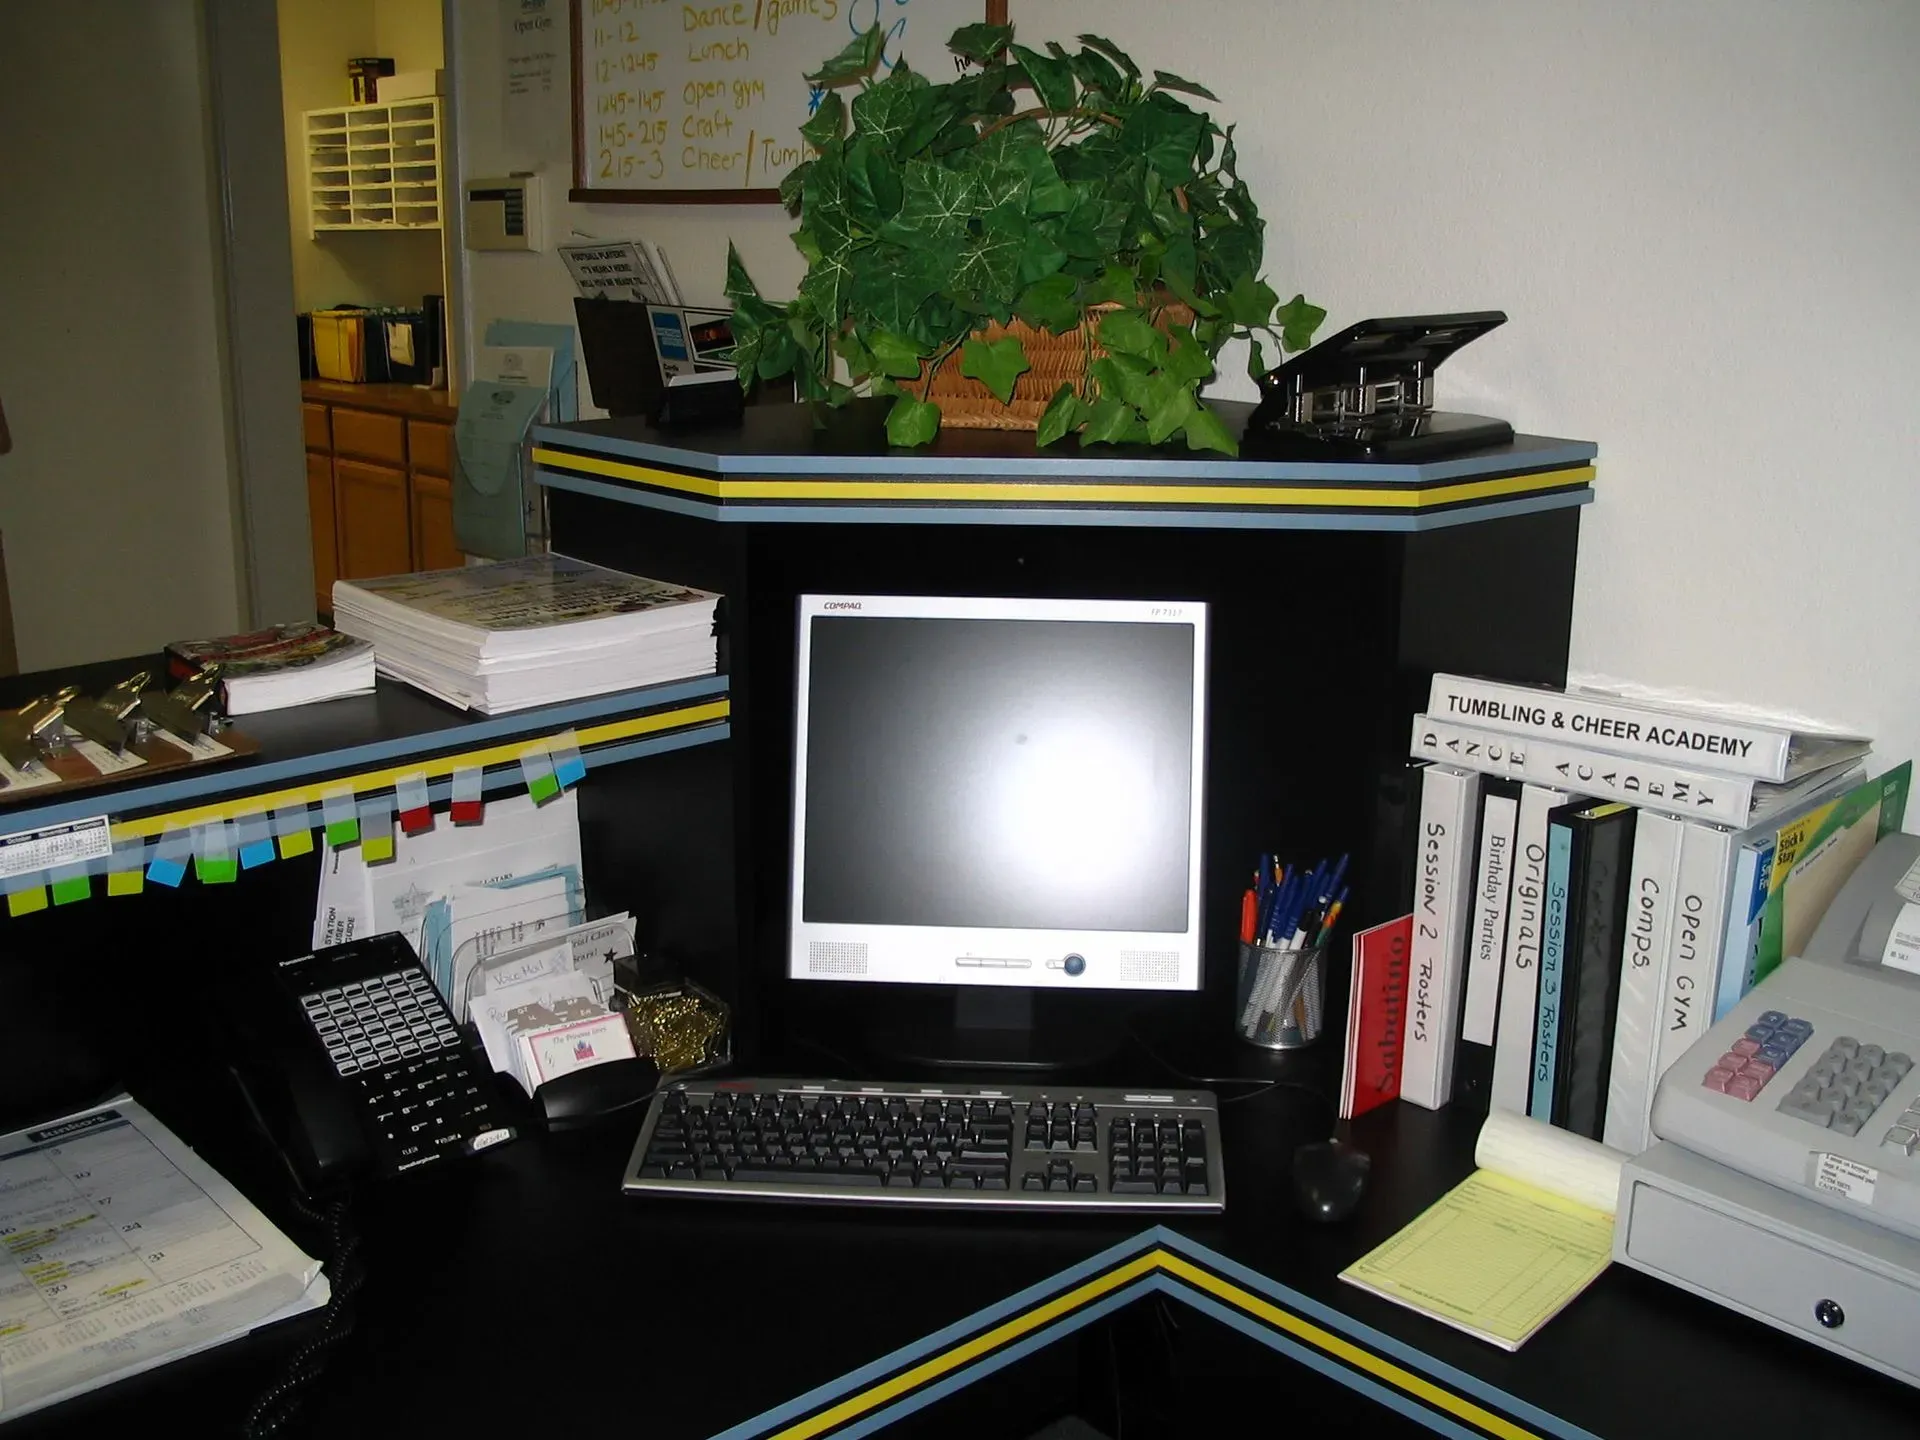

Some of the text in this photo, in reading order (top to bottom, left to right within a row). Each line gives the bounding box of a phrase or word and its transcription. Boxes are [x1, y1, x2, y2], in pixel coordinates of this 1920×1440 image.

[688, 36, 750, 62] Lunch
[682, 110, 733, 138] Craft
[823, 601, 862, 611] COMPAQ
[1448, 695, 1754, 758] TUMBLING & CHEER ACADEMY
[1424, 732, 1714, 806] DANCE ACADEMY
[1779, 834, 1799, 851] Stick
[1776, 850, 1795, 866] Stay
[1480, 834, 1506, 961] Birthday Parties
[1516, 844, 1545, 970] Originals
[325, 907, 336, 945] STATION
[1419, 923, 1438, 940] 2
[1537, 882, 1565, 1083] Session 3 Rosters
[1414, 958, 1433, 1042] Rosters
[122, 1222, 142, 1233] 24
[149, 1252, 165, 1263] 31
